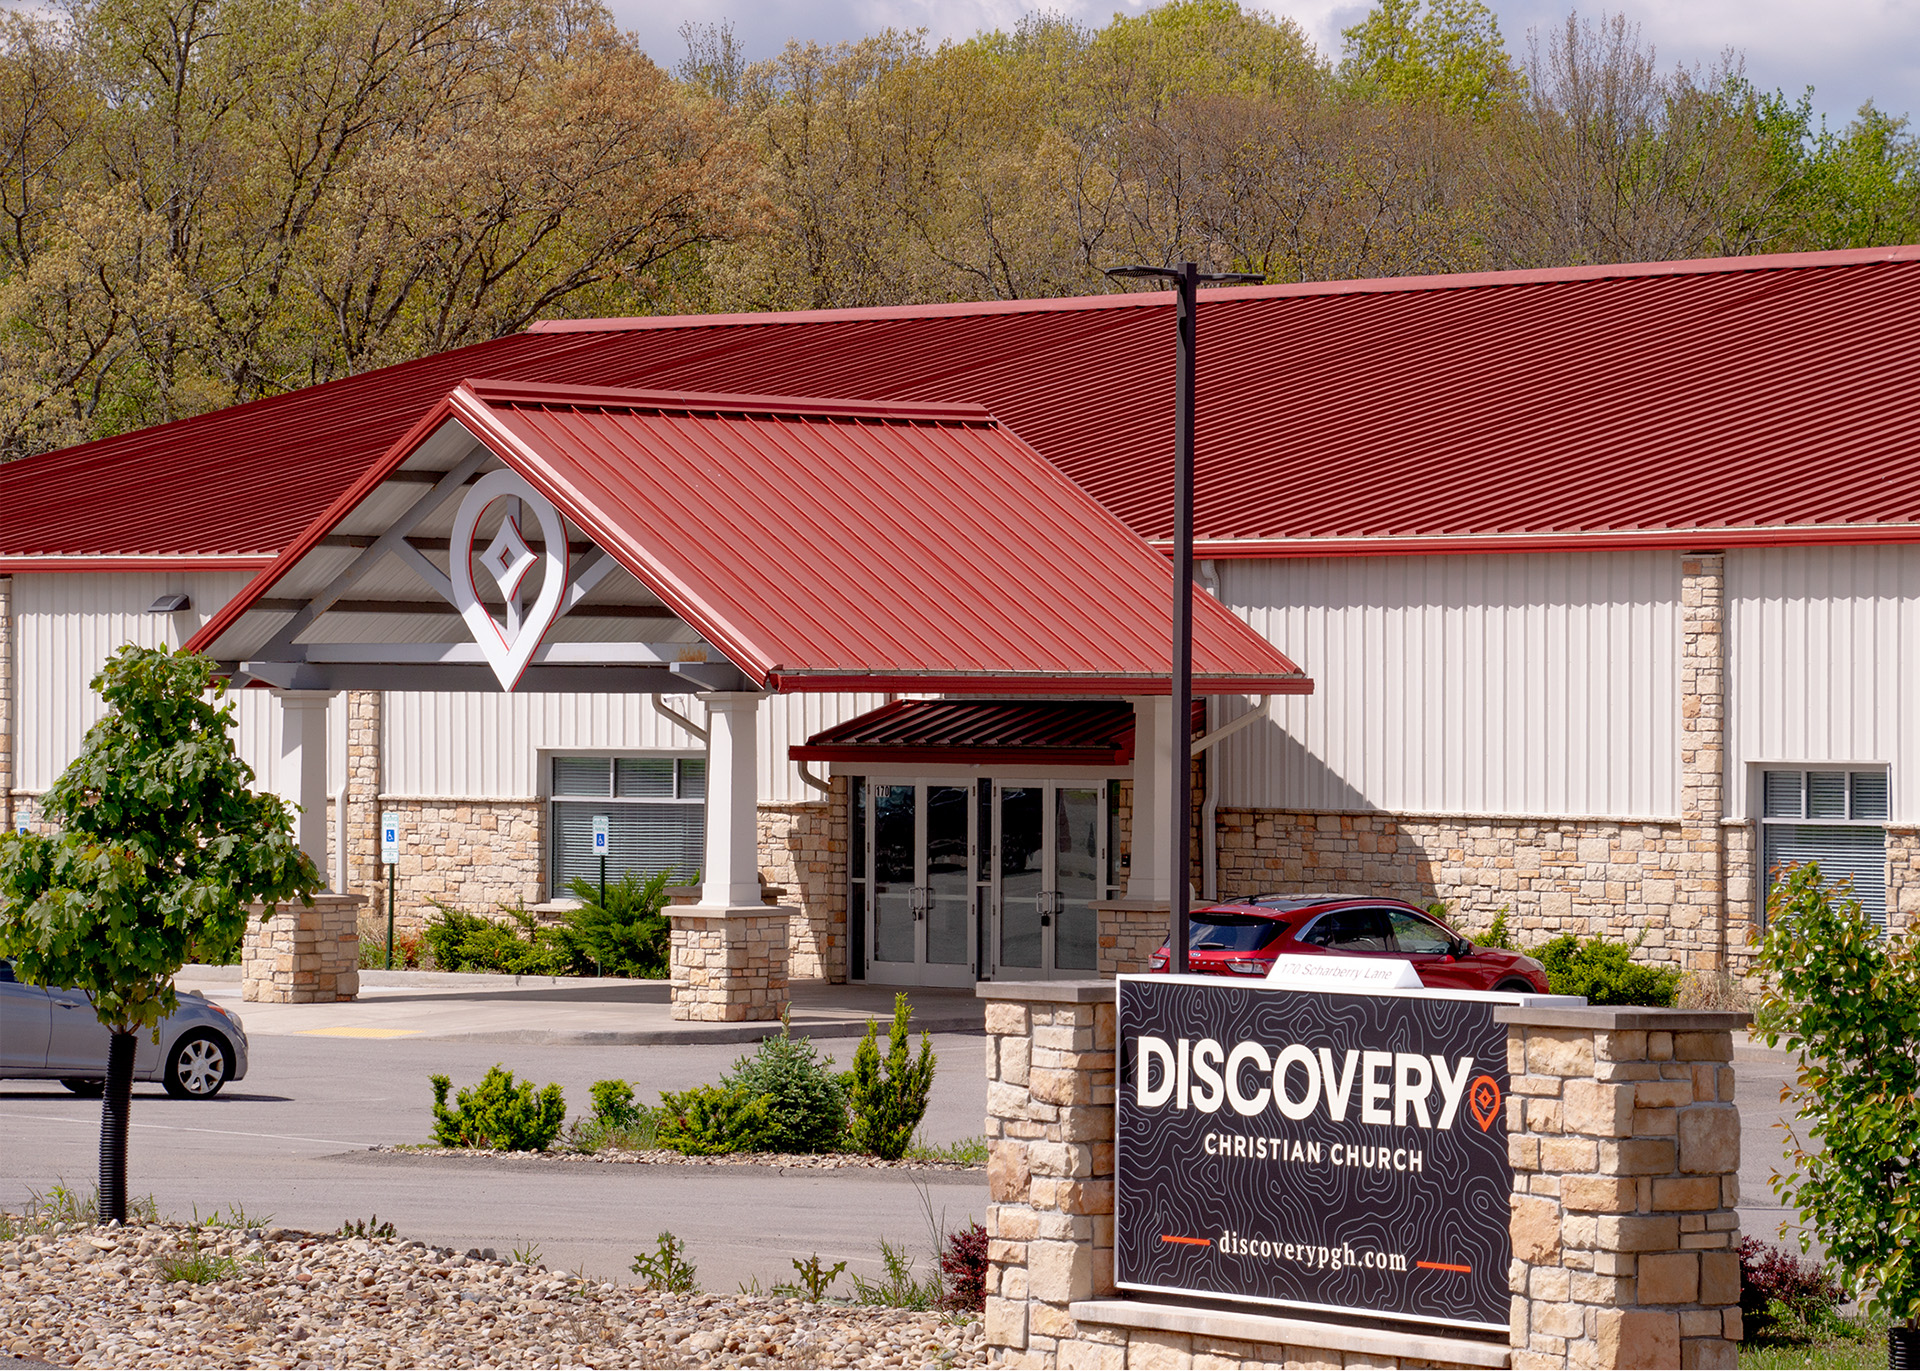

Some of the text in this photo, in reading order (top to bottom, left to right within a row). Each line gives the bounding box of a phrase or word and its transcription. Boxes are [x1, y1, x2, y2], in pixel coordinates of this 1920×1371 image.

[876, 785, 890, 797] 170
[1281, 963, 1393, 981] 170 Scharberry Lane
[1137, 1036, 1475, 1130] DISCOVERY
[1204, 1132, 1423, 1172] CHRISTIAN CHURCH
[1219, 1230, 1408, 1271] discoverypgh.com
